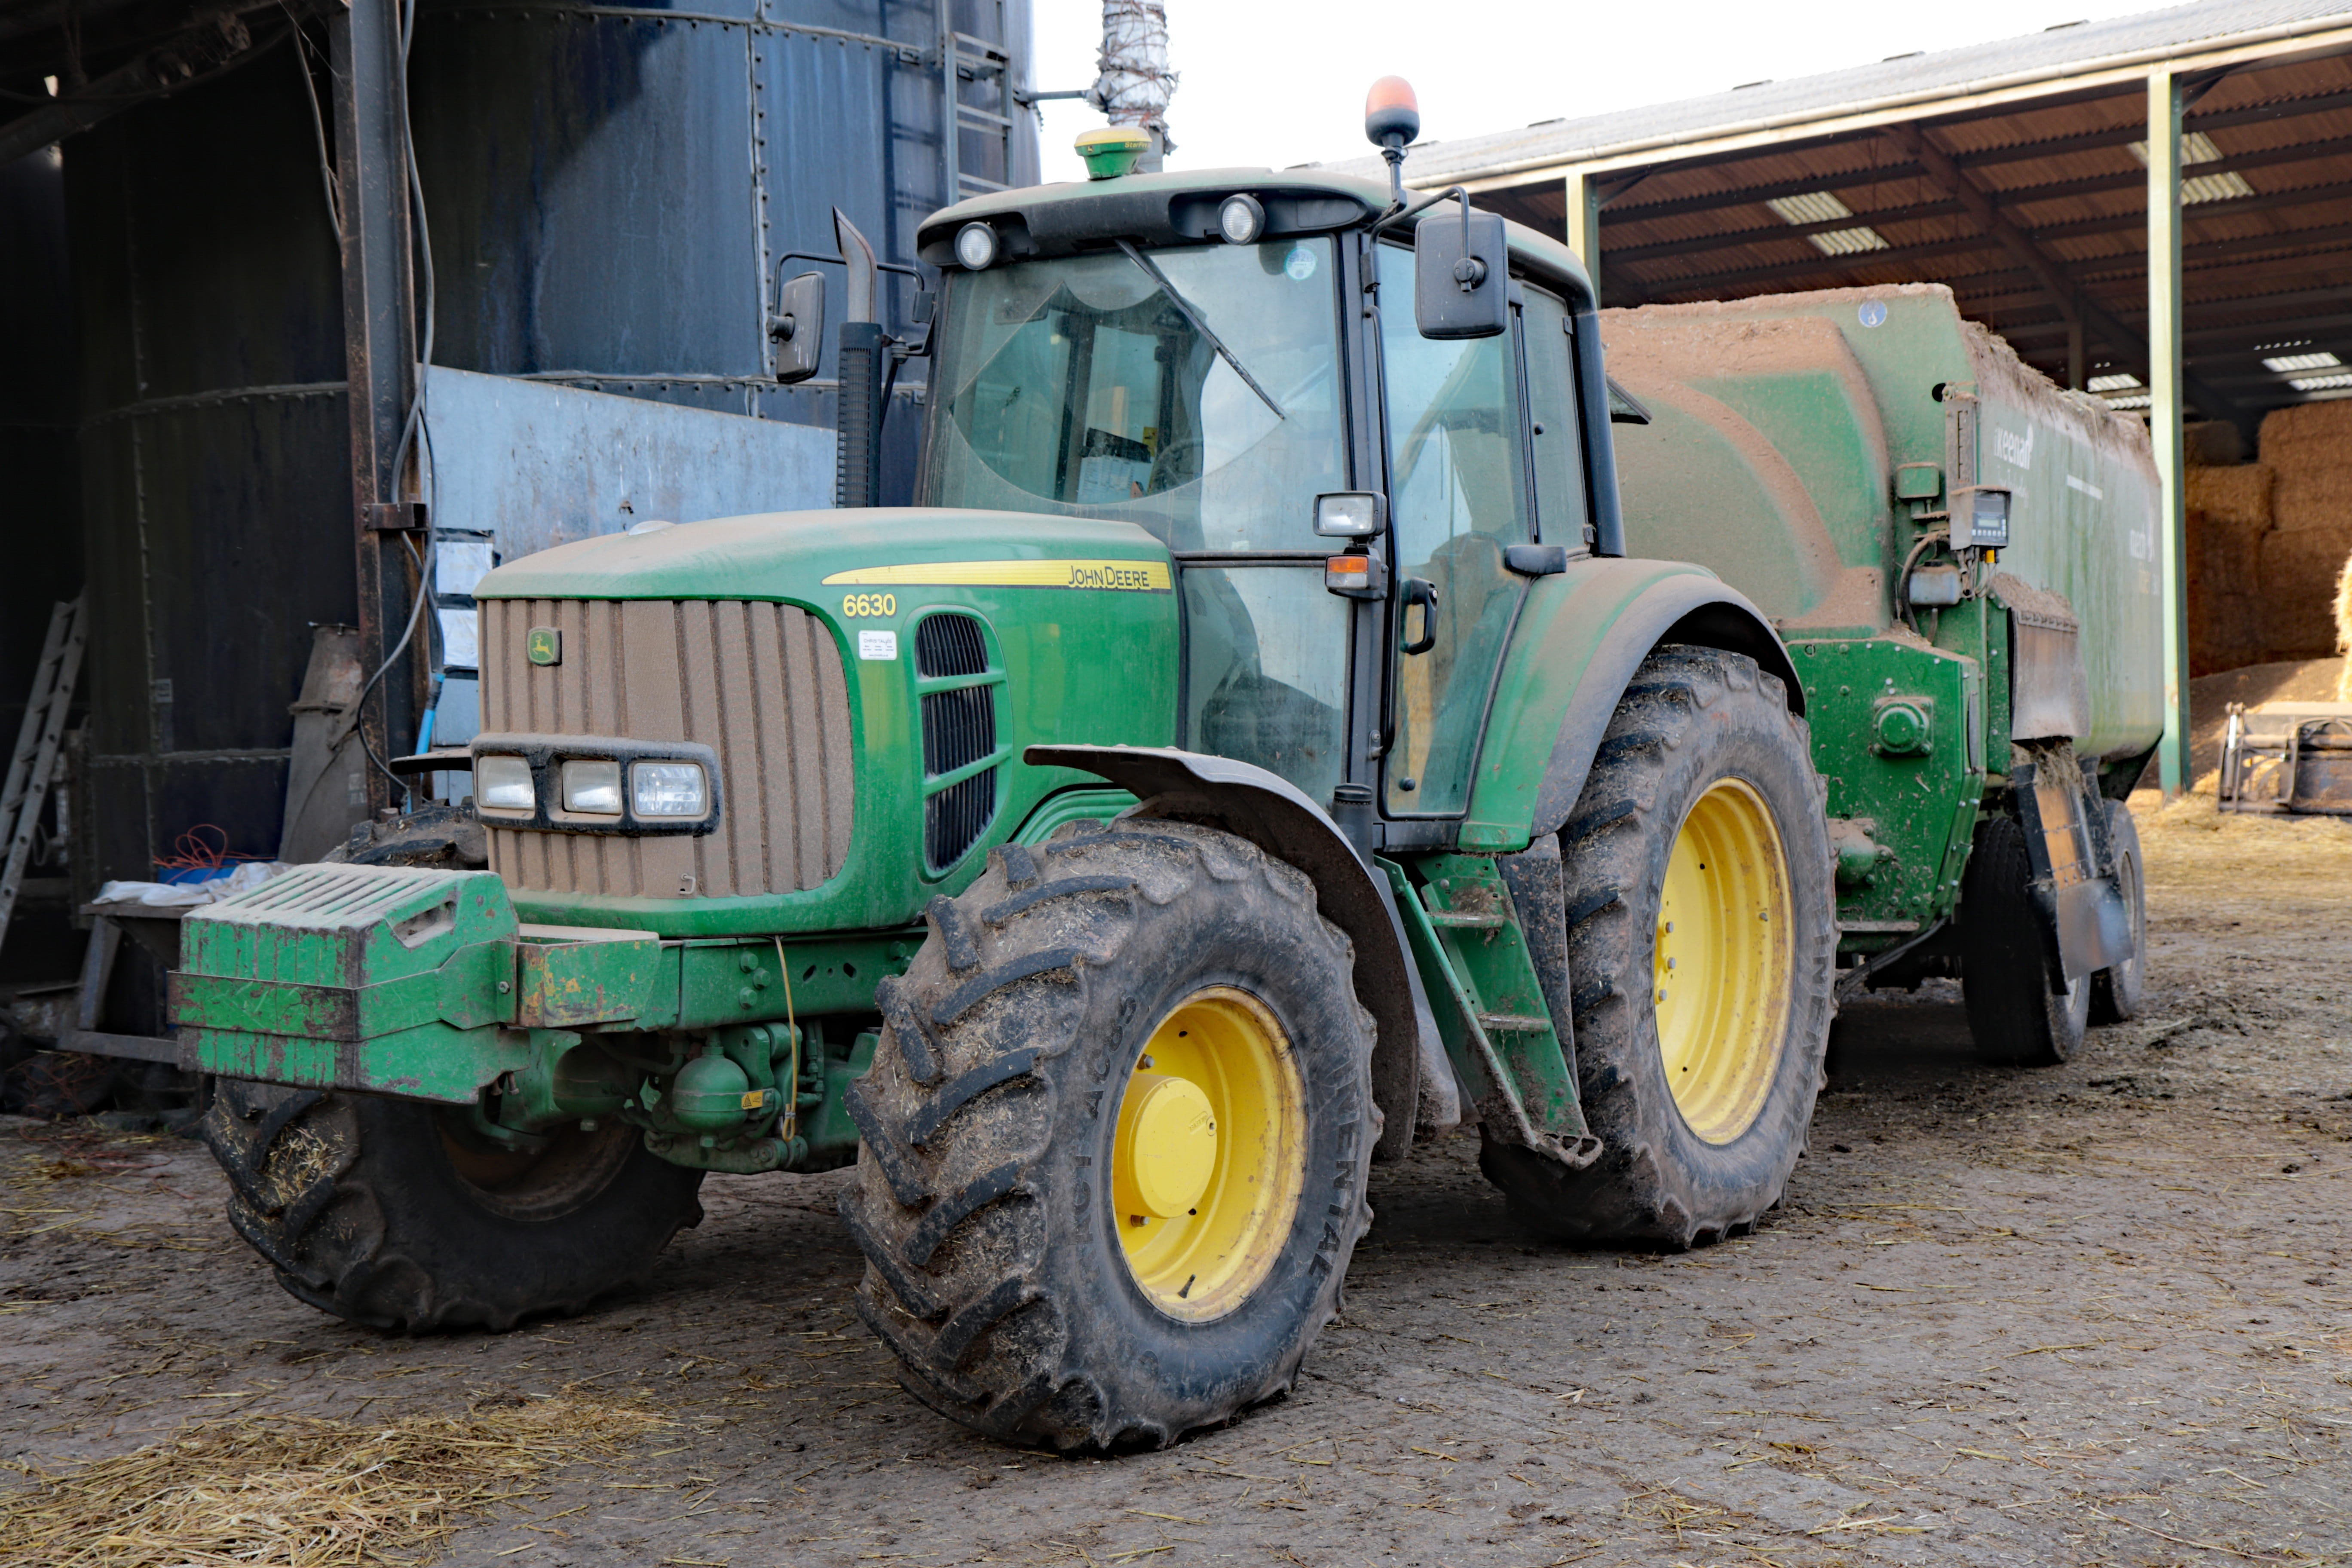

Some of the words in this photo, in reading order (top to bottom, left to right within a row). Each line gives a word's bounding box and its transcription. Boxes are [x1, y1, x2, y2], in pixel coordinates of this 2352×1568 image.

[1069, 565, 1104, 585] JOHN
[1105, 566, 1149, 587] DEERE
[843, 594, 896, 618] 6630
